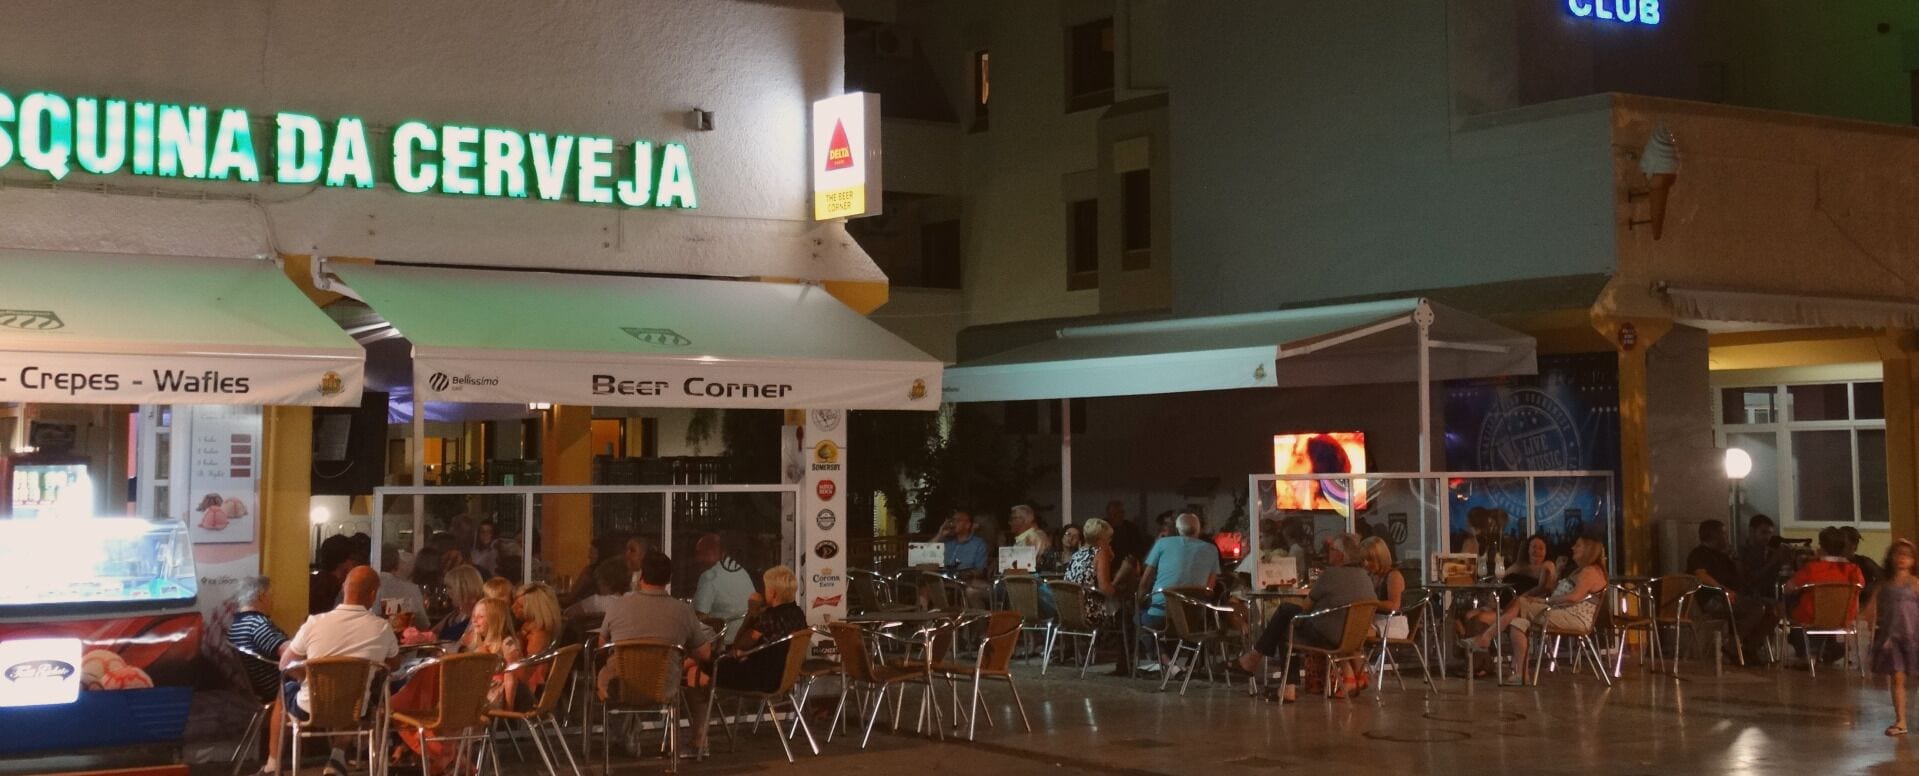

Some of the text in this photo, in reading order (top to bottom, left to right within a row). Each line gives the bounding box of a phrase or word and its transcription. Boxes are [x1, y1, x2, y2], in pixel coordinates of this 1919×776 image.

[1568, 0, 1660, 24] CLUB
[276, 112, 374, 189] DA
[392, 120, 698, 209] CERVEJA
[826, 190, 853, 203] THE BEER
[828, 201, 851, 211] CORNER
[20, 366, 120, 396] Crepes
[153, 369, 250, 394] Wafles
[452, 374, 499, 386] Bellissimo
[592, 374, 792, 398] Beer Corner
[1523, 433, 1548, 456] LIVE
[1526, 449, 1563, 471] MUSIC
[813, 574, 840, 583] Corona
